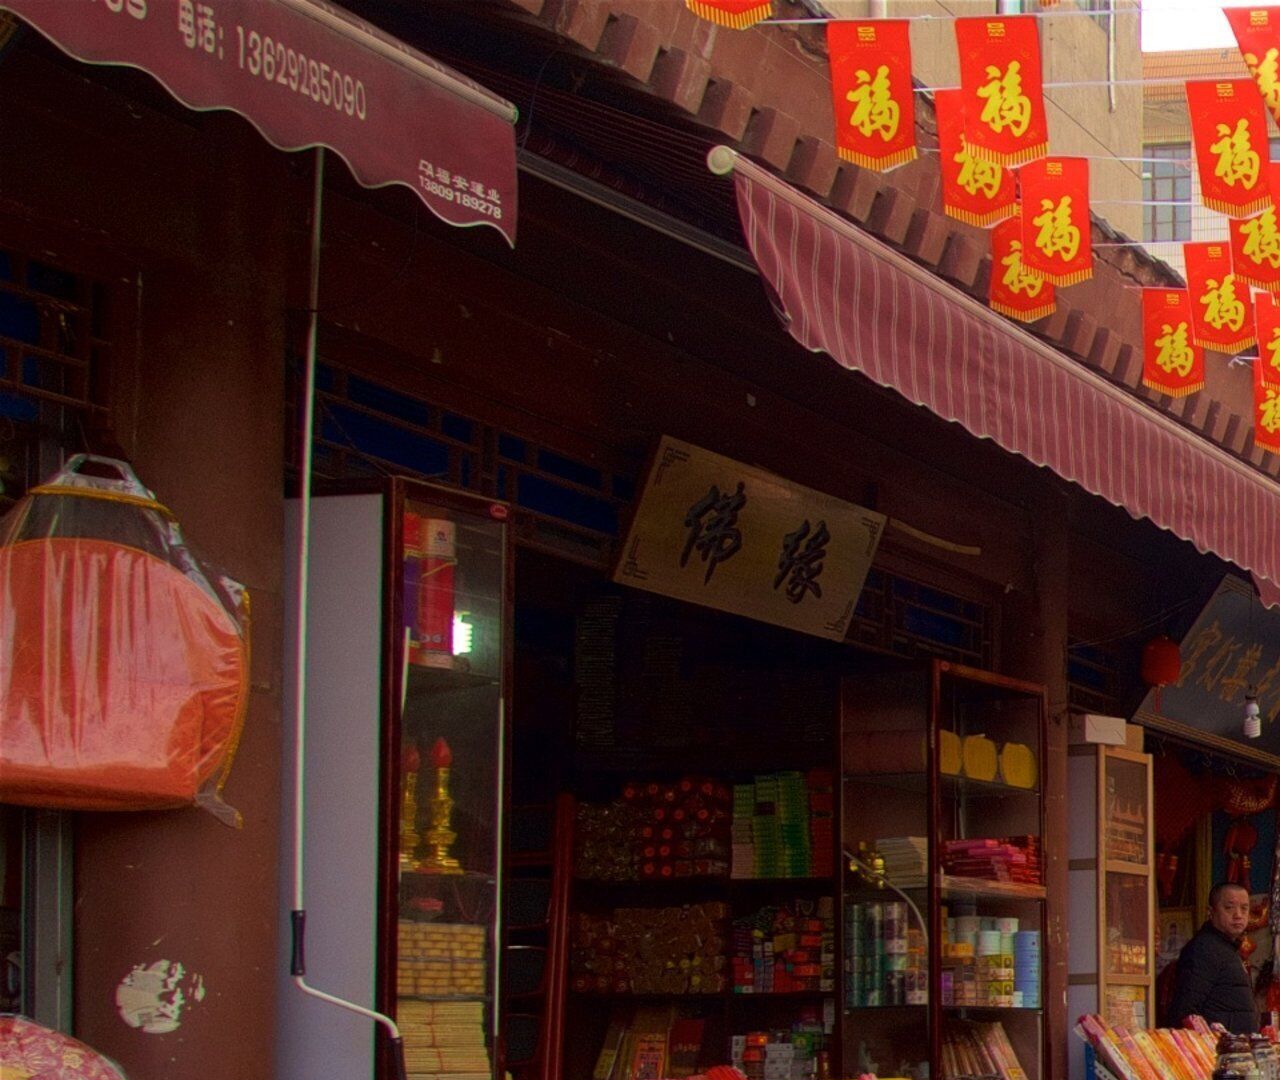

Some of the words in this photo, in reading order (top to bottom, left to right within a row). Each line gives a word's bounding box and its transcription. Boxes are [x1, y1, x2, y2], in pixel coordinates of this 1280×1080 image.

[236, 25, 367, 121] 13629285090
[846, 65, 900, 142] 福
[976, 60, 1032, 138] 福
[954, 138, 1003, 199] 福
[1209, 118, 1260, 190] 福
[418, 175, 503, 220] 13809189278
[1033, 195, 1081, 262] 福
[1199, 273, 1246, 332] 福
[1154, 321, 1195, 377] 福
